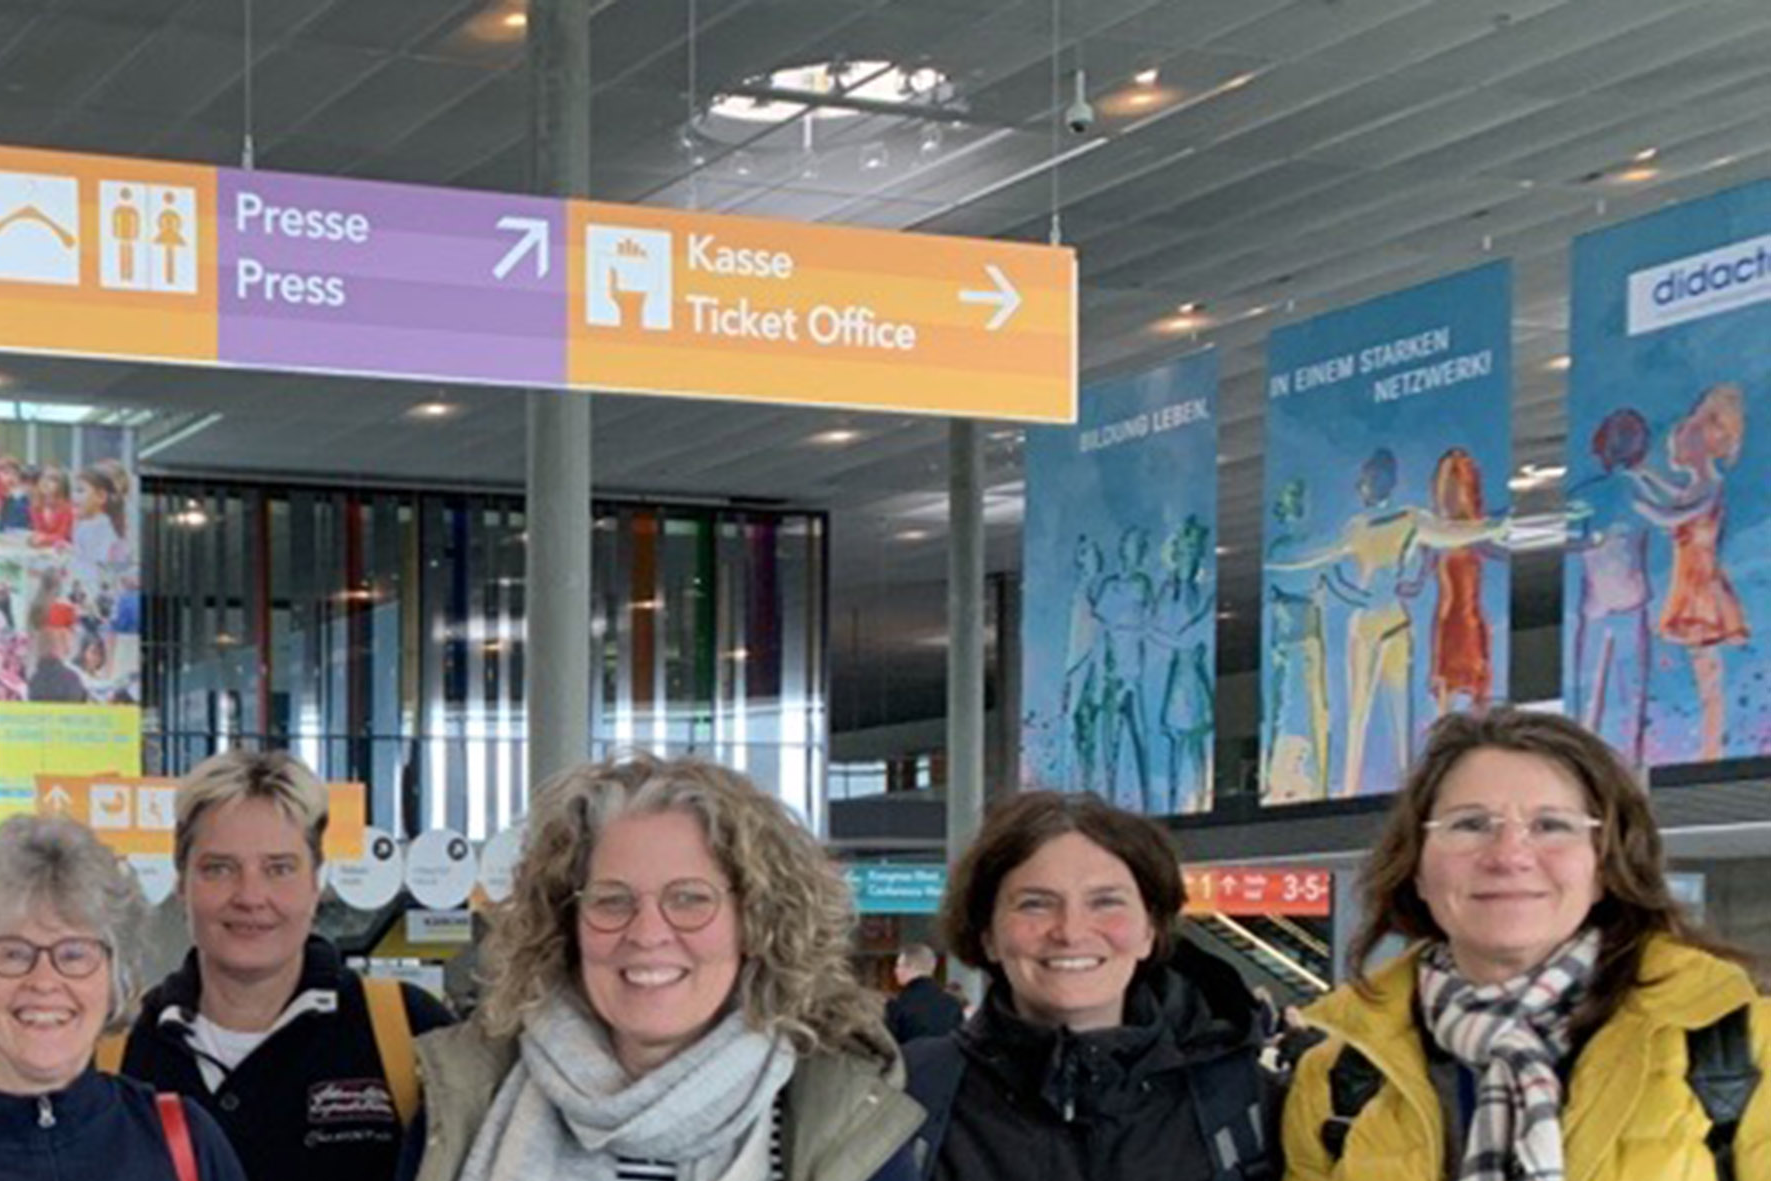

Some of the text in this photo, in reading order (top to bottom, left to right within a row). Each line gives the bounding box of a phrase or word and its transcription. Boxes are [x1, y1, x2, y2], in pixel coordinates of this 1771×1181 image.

[236, 191, 370, 243] Presse
[237, 258, 346, 307] Press
[687, 233, 794, 279] Kasse
[1652, 246, 1771, 306] didact
[686, 293, 917, 350] Ticket Office
[1269, 327, 1450, 398] IN EINEM STARKEN
[1374, 349, 1493, 403] NETZWERK!
[1283, 873, 1329, 902] 3-5-
